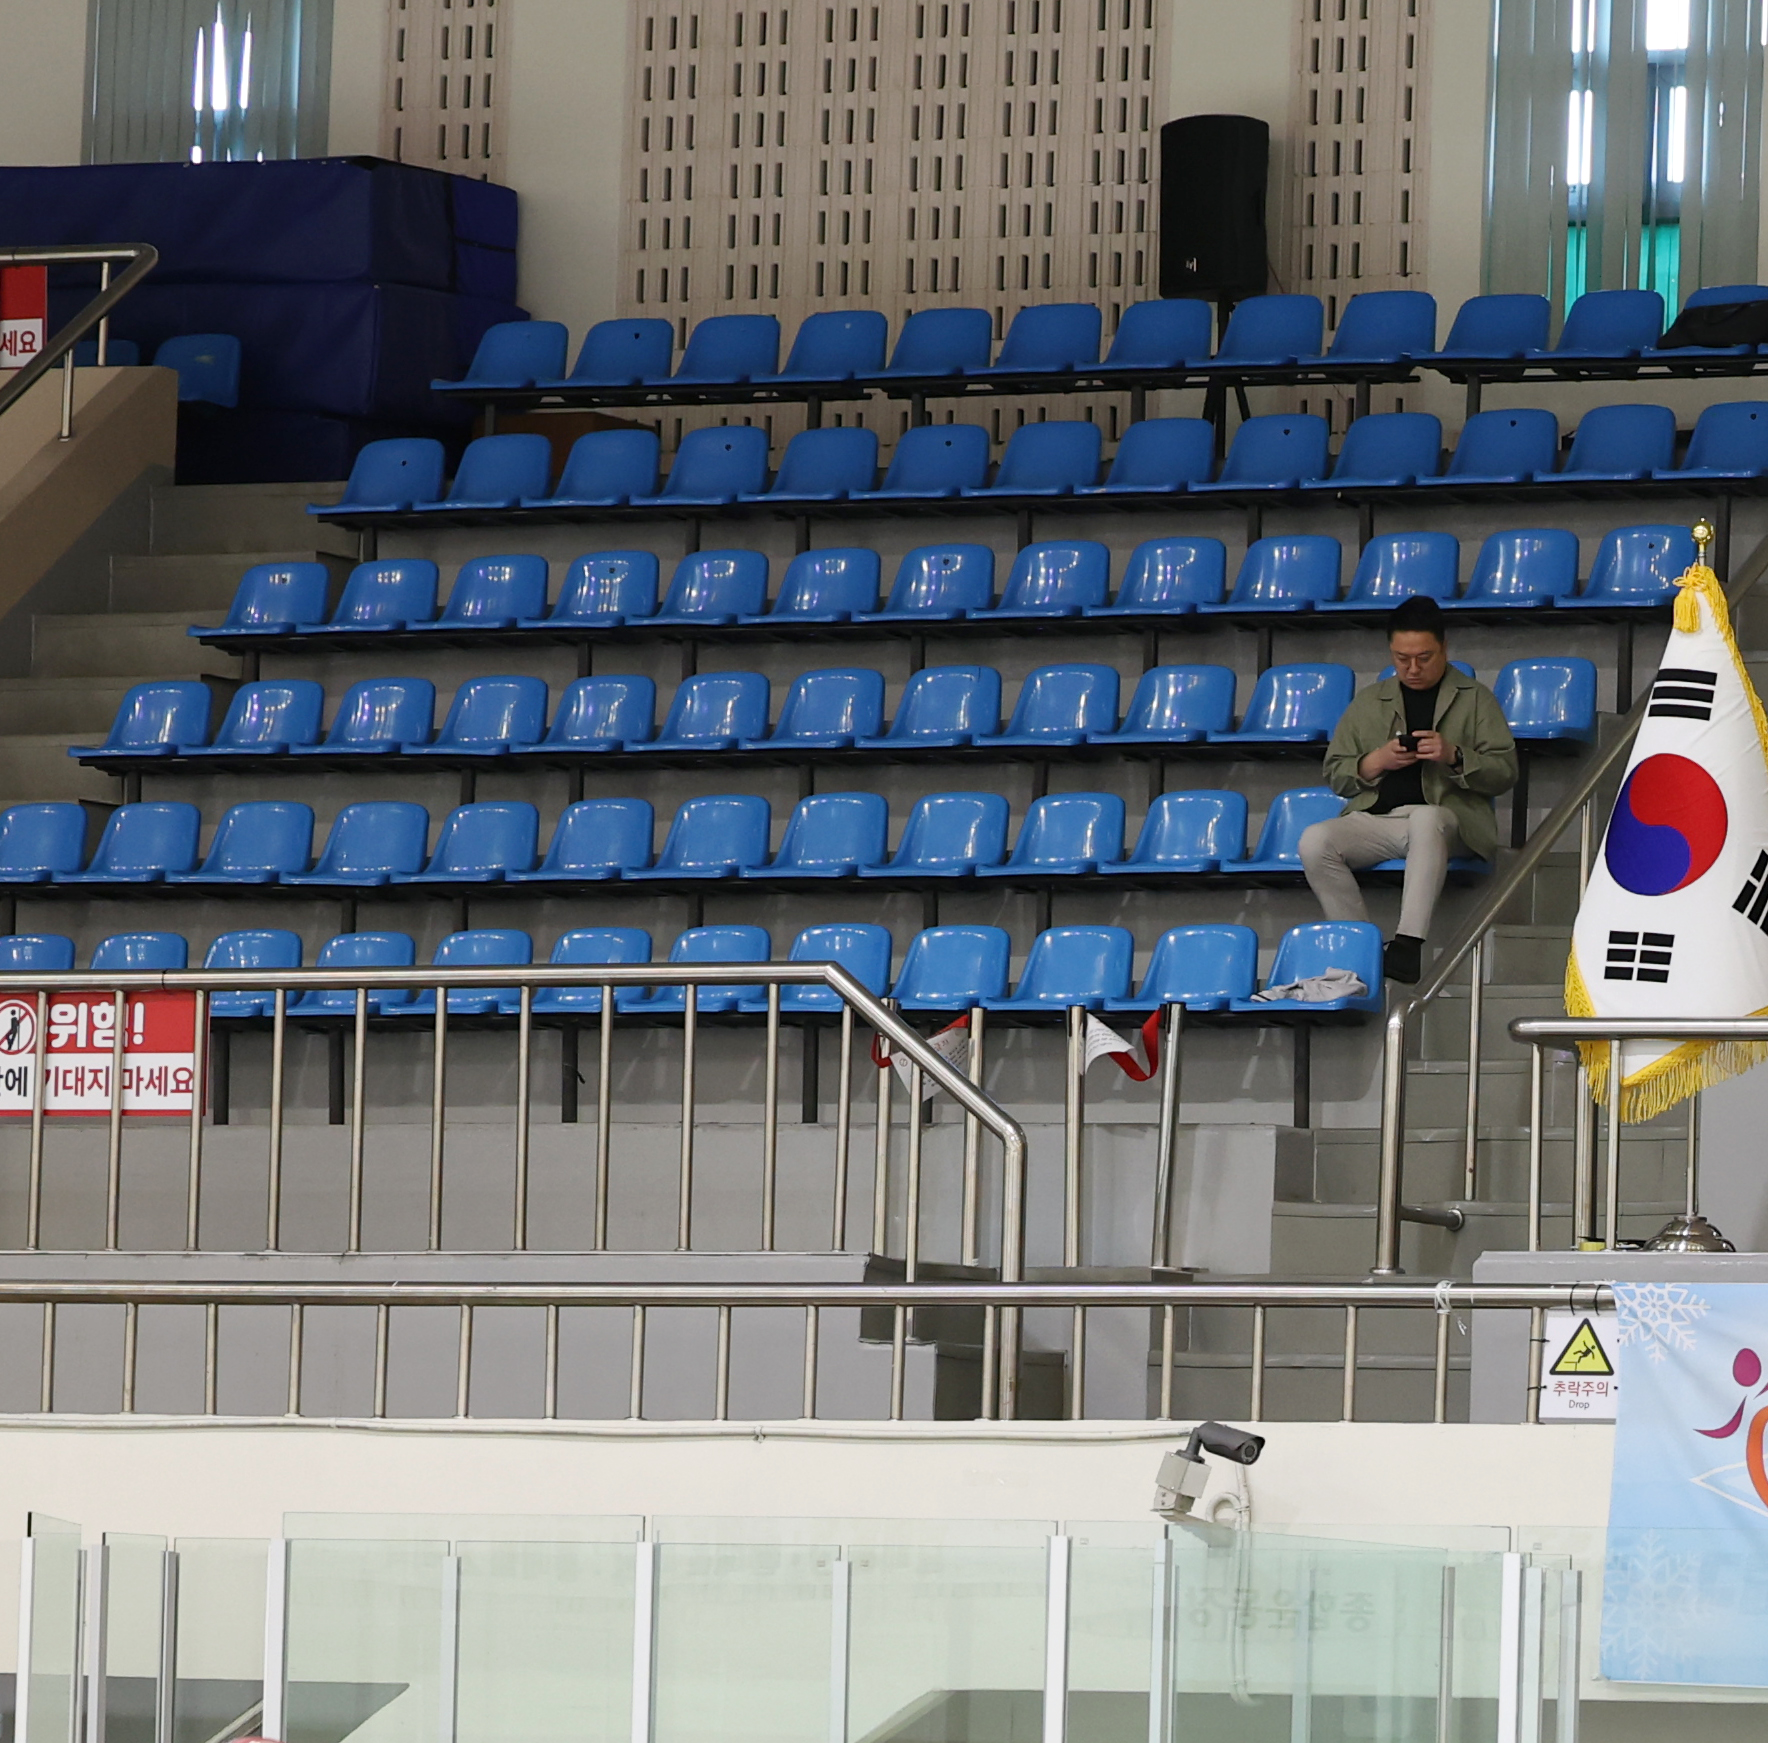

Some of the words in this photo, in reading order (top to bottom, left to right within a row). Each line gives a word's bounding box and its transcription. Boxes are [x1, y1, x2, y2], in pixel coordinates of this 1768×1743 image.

[49, 1001, 145, 1048] 위험!
[122, 1065, 193, 1098] 마세요
[1553, 1381, 1609, 1397] 추락주의
[1568, 1400, 1590, 1410] Drop
